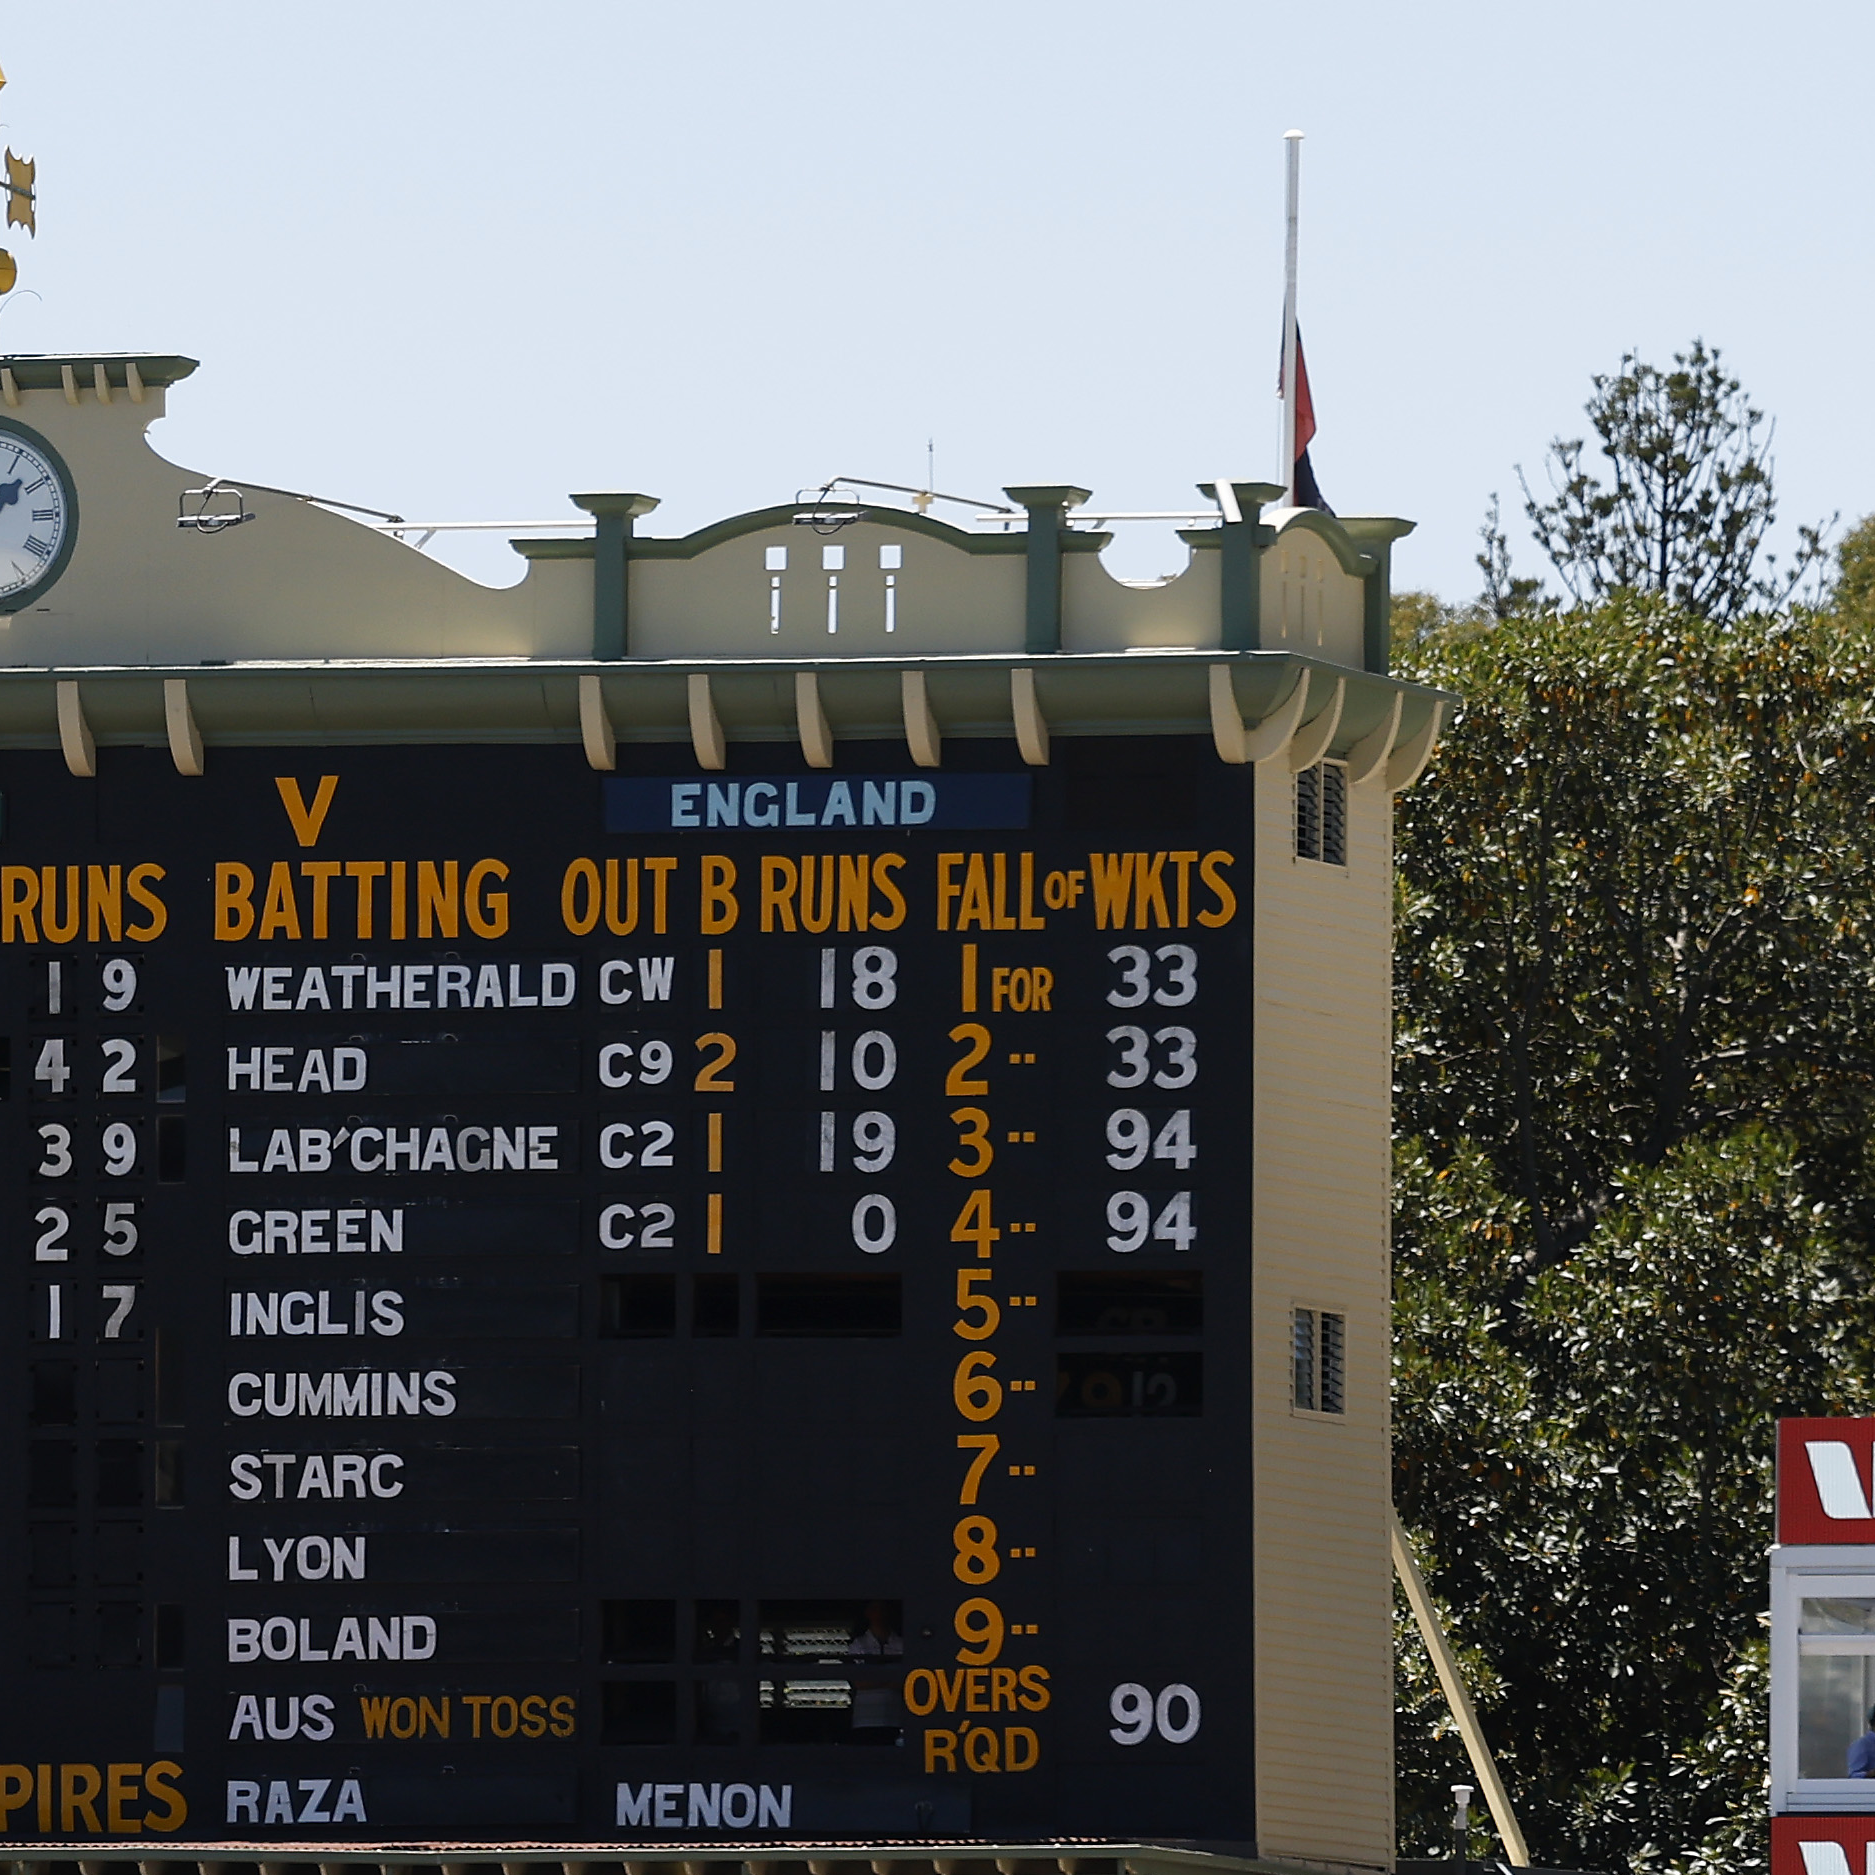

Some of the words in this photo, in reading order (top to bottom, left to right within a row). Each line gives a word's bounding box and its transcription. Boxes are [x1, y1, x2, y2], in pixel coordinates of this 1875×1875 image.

[274, 775, 340, 847] V
[671, 780, 937, 828] ENGLAND
[0, 862, 168, 944] RUNS
[214, 858, 510, 942] BATTING
[561, 856, 678, 936] OUT
[700, 854, 739, 935] B
[760, 852, 907, 934] RUNS
[937, 851, 1048, 931] FALL
[1043, 870, 1086, 910] OF
[1089, 850, 1237, 930] WKTS
[224, 963, 576, 1011] WEATHERALD
[599, 956, 675, 1005] CW
[708, 948, 723, 1010] 1
[820, 945, 898, 1010] 18
[962, 943, 978, 1013] 1
[992, 966, 1054, 1013] FOR
[1106, 943, 1198, 1008] 33
[227, 1046, 367, 1094] HEAD
[599, 1040, 673, 1088] C9
[694, 1032, 737, 1092] 2
[820, 1030, 897, 1091] 10
[945, 1022, 992, 1097] 2
[1105, 1025, 1198, 1090] 33
[229, 1126, 559, 1173] LAB'CHAGNE
[599, 1120, 674, 1169] C2
[708, 1112, 722, 1173] 1
[819, 1110, 896, 1173] 19
[947, 1106, 994, 1178] 3
[1105, 1108, 1197, 1171] 94
[228, 1209, 404, 1255] GREEN
[599, 1202, 675, 1250] C2
[707, 1193, 722, 1254] 1
[851, 1193, 897, 1254] 0
[950, 1189, 1001, 1259] 4
[1106, 1190, 1197, 1253] 94
[230, 1290, 404, 1337] INGLIS
[952, 1268, 1001, 1341] 5
[228, 1370, 457, 1417] CUMMINS
[953, 1350, 1003, 1422] 6
[229, 1453, 404, 1500] STARC
[956, 1433, 1001, 1505] 7
[228, 1535, 366, 1582] LYON
[953, 1514, 1001, 1585] 8
[227, 1615, 437, 1663] BOLAND
[954, 1597, 1005, 1666] 9
[228, 1694, 335, 1741] AUS
[360, 1696, 450, 1739] WON
[462, 1695, 574, 1738] TOSS
[904, 1665, 1051, 1716] OVERS
[1109, 1682, 1201, 1745] 90
[226, 1778, 367, 1824] RAZA
[616, 1782, 792, 1828] MENON
